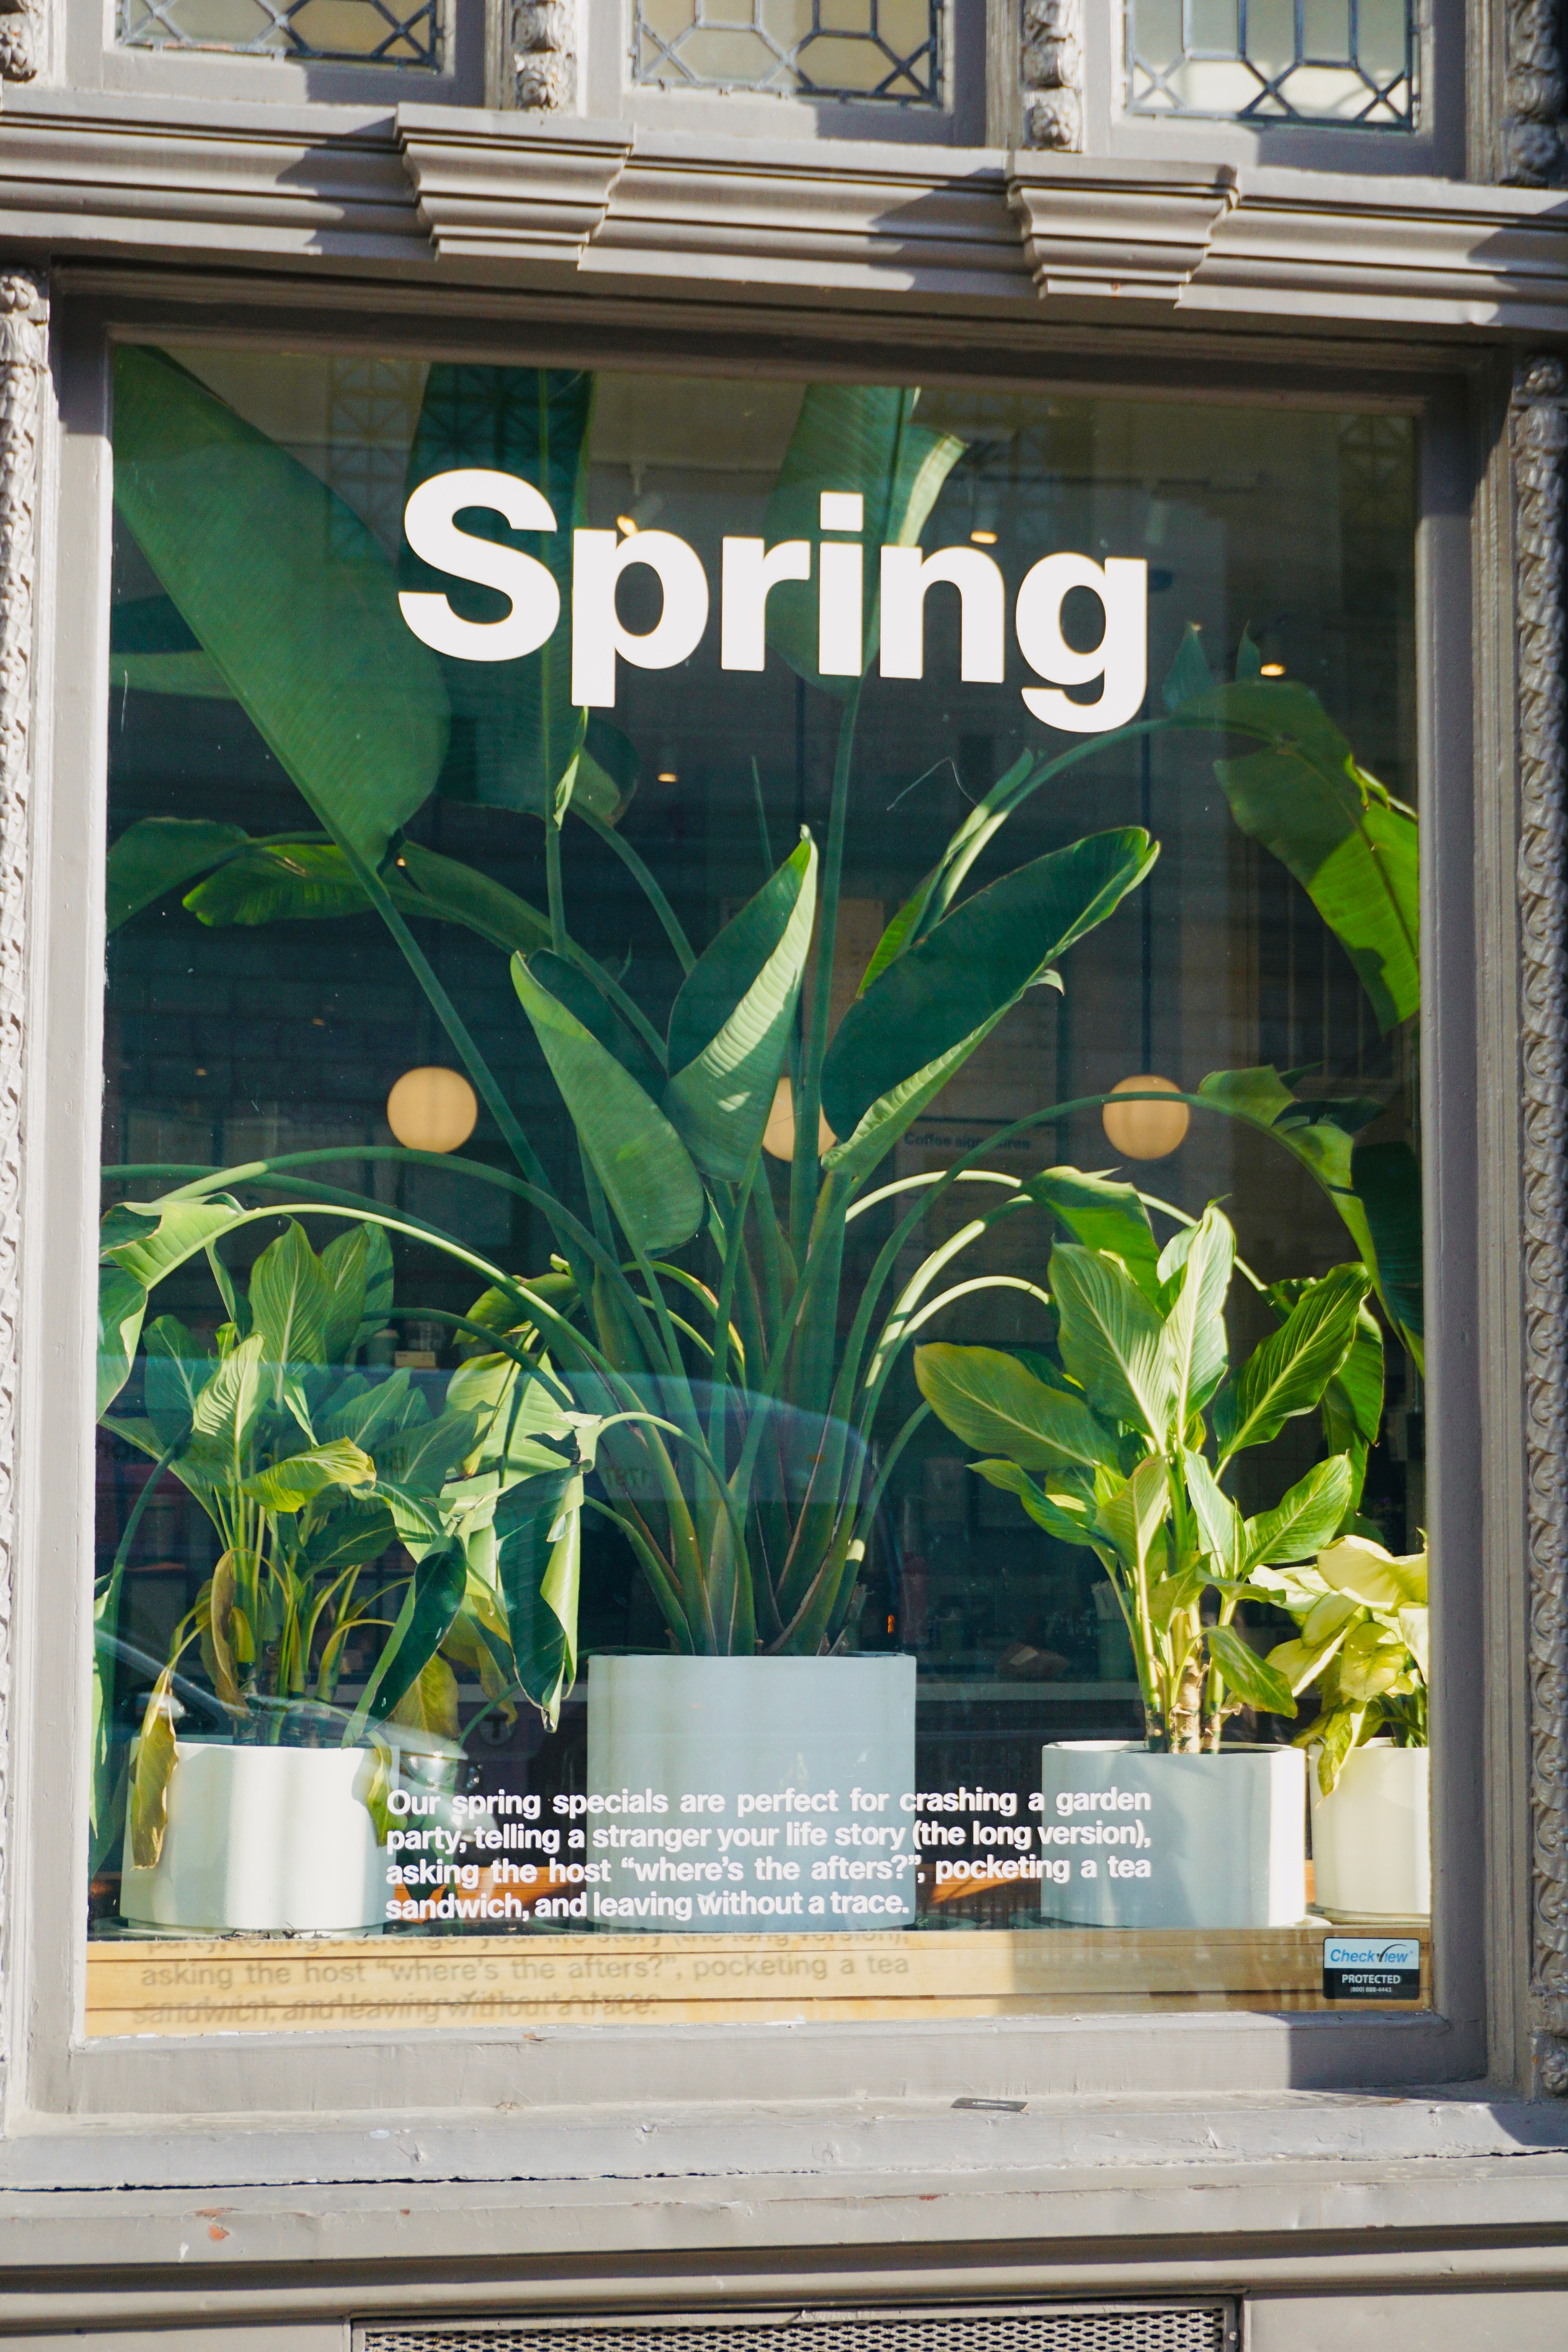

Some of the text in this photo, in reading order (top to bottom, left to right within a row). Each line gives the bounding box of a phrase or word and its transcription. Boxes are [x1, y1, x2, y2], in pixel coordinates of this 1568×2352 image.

[399, 470, 1146, 732] Spring
[904, 1131, 951, 1146] Coffee
[387, 1787, 1151, 1820] Our spring specials are perfect for crashing a garden
[387, 1819, 1151, 1855] party, telling a stranger your life story (the long version),
[386, 1854, 1151, 1889] asking the host “where’s the afters?”, pocketing a tea
[386, 1890, 909, 1921] sandwich, and leaving without a trace.
[1342, 1974, 1401, 1984] PROTECTED
